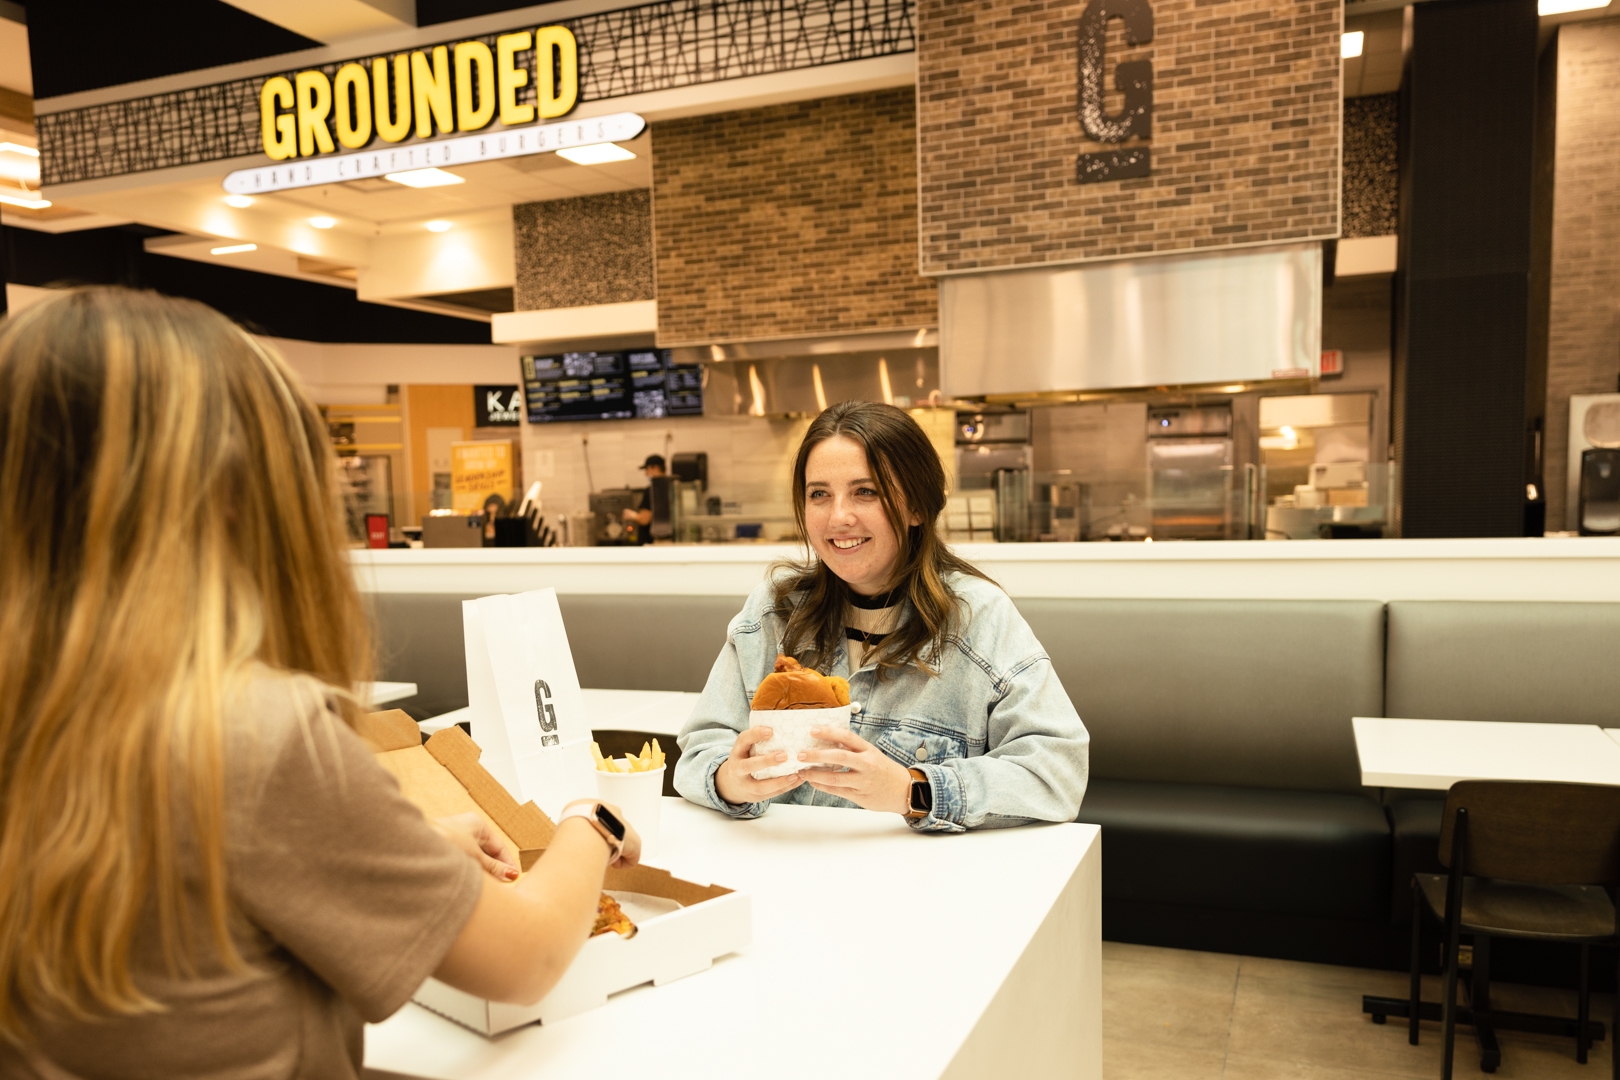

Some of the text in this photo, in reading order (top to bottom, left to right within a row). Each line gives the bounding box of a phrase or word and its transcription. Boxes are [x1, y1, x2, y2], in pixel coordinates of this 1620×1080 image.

[260, 25, 577, 160] GROUNDED
[1078, 0, 1153, 142] G
[254, 122, 605, 188] HAND CRAFTED BURGERS
[534, 679, 558, 733] G
